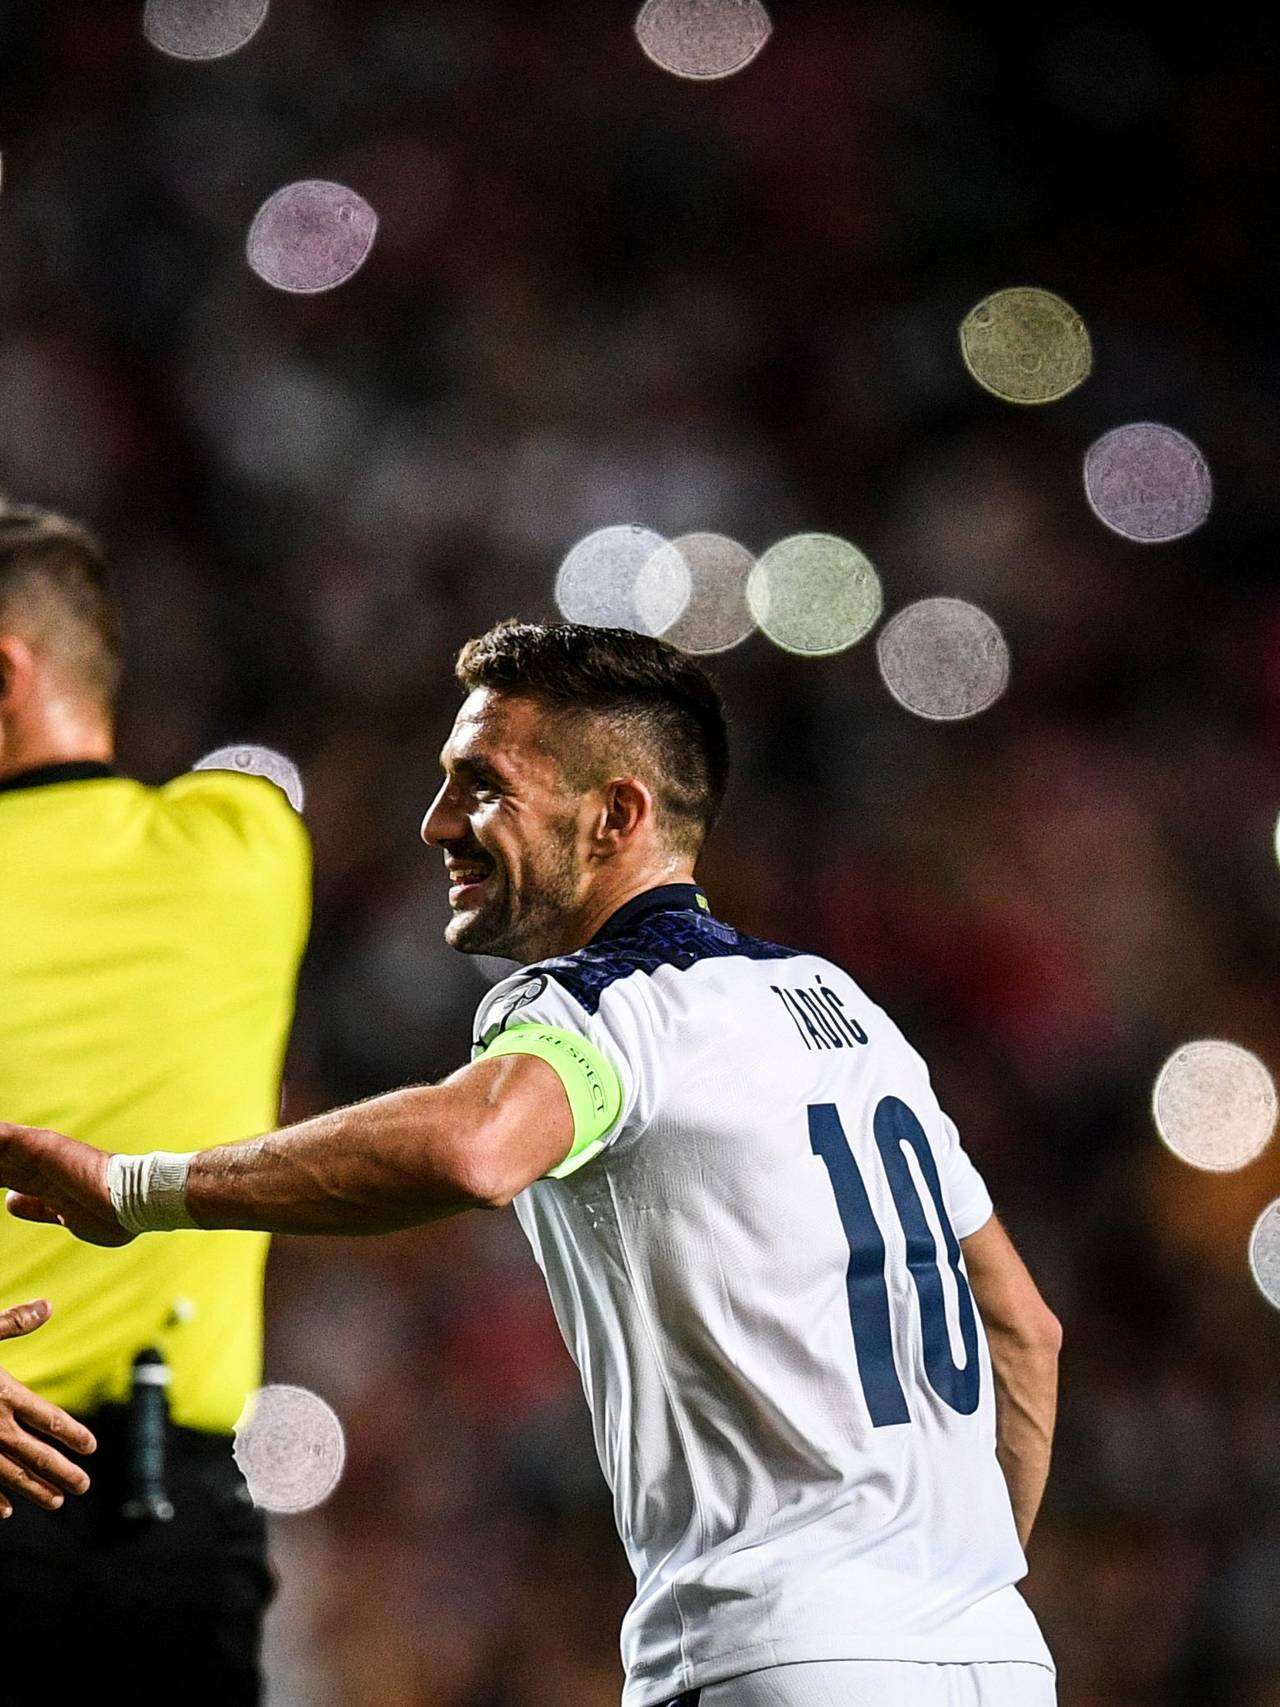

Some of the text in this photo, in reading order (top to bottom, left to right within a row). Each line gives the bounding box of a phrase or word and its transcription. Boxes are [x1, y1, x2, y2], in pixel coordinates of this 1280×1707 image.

[770, 975, 868, 1050] TADIĆ
[538, 1034, 605, 1112] RESPECT
[807, 1096, 980, 1428] 10
